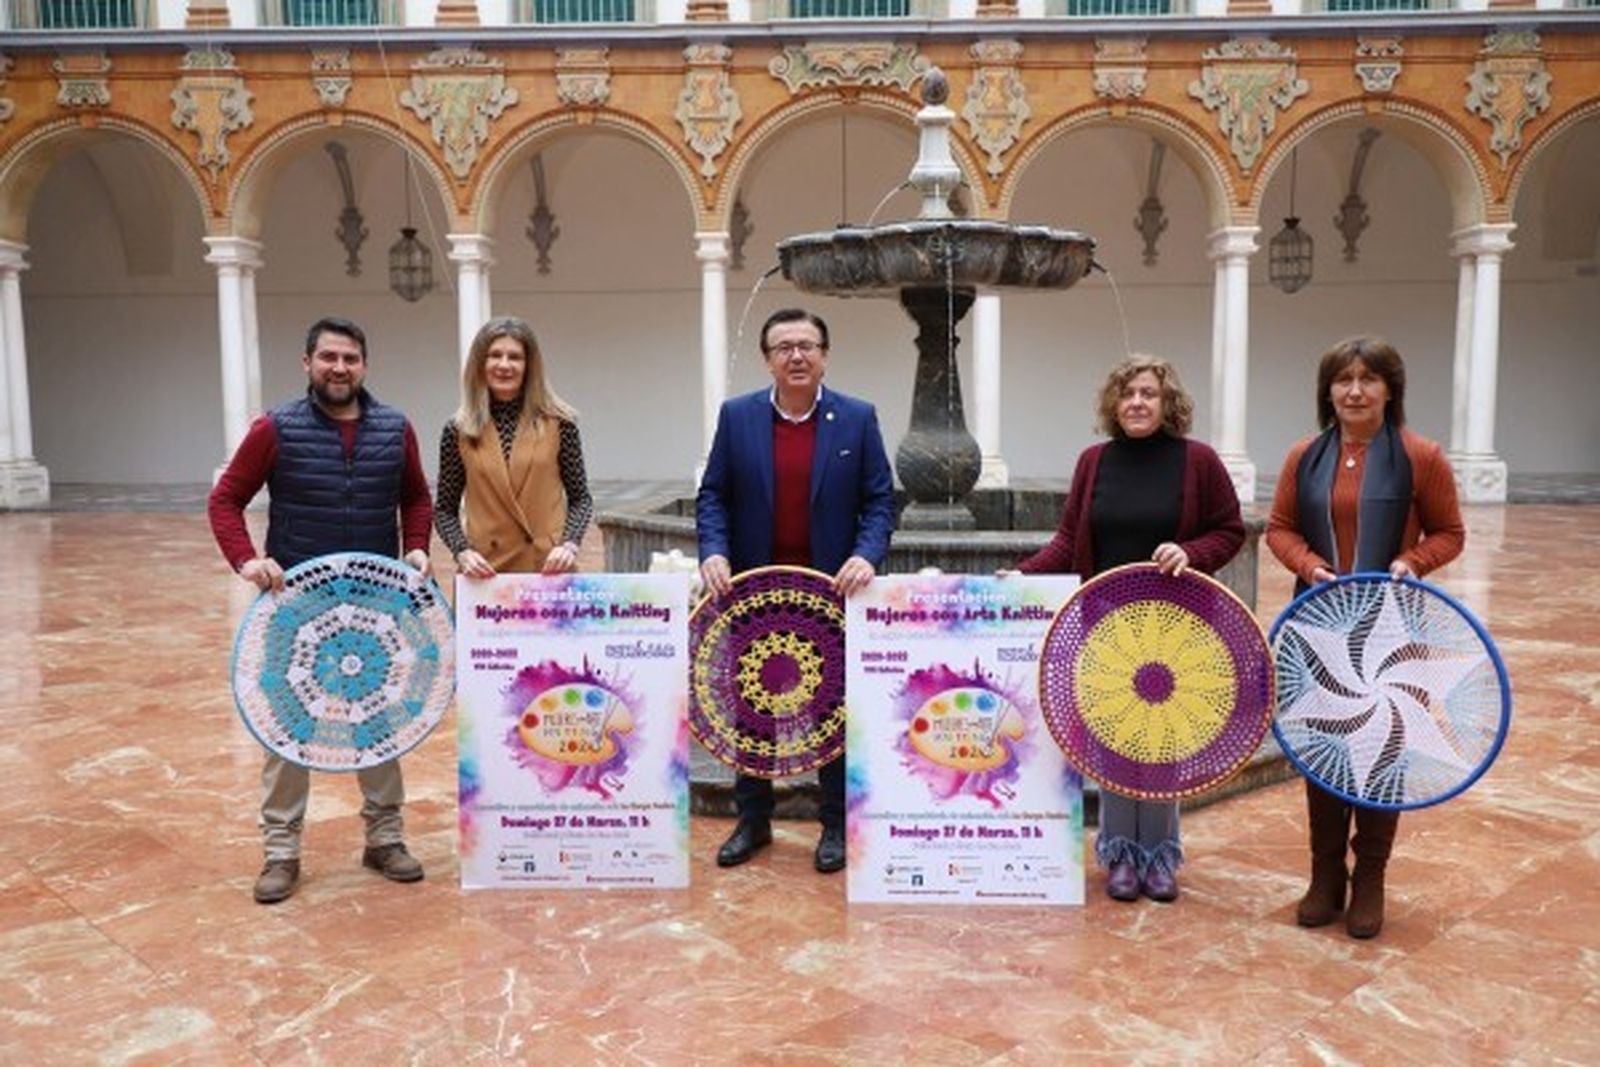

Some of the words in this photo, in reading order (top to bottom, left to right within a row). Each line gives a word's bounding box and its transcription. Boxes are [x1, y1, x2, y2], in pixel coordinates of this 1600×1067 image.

[475, 604, 537, 622] Mujeres
[540, 607, 569, 620] con
[572, 604, 607, 620] Arte
[609, 602, 671, 622] Knitting
[866, 607, 927, 625] Mujeres
[931, 610, 960, 622] con
[963, 606, 998, 622] Arte
[1001, 605, 1055, 622] Knittin
[501, 815, 550, 831] Domingo
[553, 816, 566, 828] 27
[569, 815, 584, 828] de
[629, 816, 638, 828] 11
[642, 816, 650, 828] h
[890, 825, 940, 841] Domingo
[943, 826, 956, 838] 27
[959, 825, 974, 838] de
